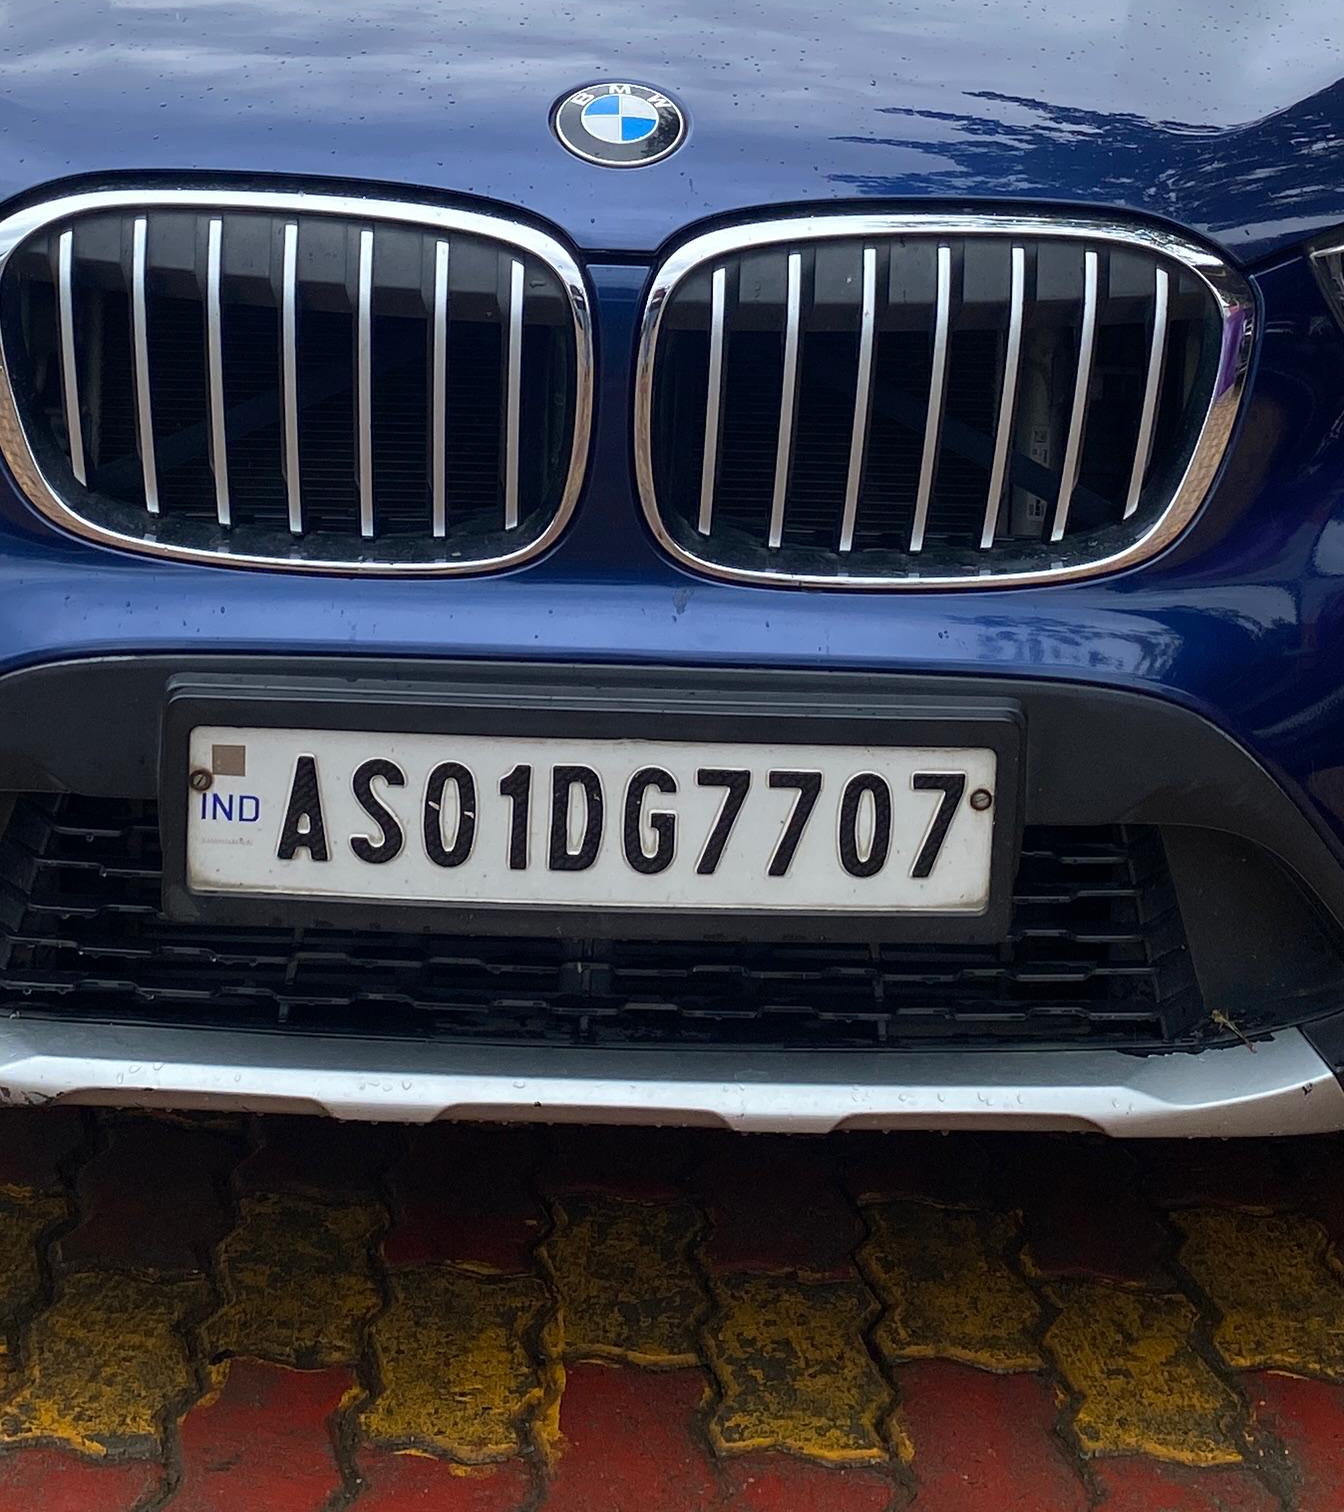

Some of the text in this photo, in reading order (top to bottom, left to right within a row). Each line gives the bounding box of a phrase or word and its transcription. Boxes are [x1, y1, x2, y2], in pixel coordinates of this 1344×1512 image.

[571, 84, 673, 108] BMW
[200, 754, 966, 879] IND AS01DG7707
